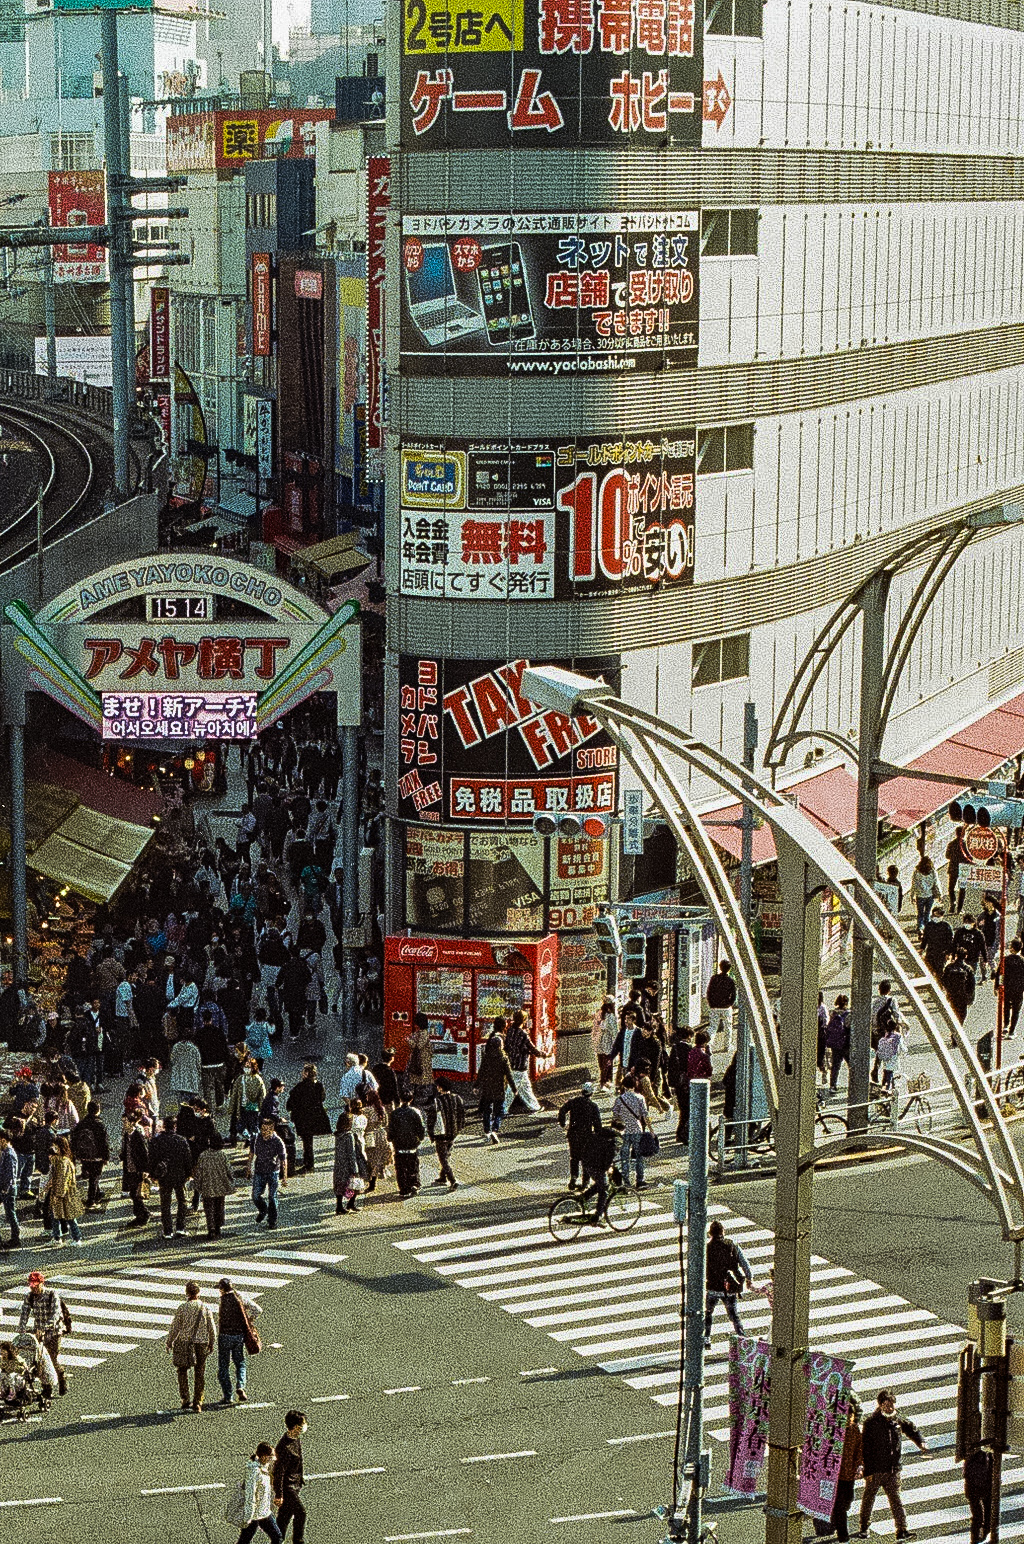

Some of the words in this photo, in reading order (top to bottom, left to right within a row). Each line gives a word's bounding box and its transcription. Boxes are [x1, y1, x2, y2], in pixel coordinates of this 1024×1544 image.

[404, 0, 514, 52] 2号店へ
[538, 0, 695, 57] 携帯電話
[409, 68, 564, 136] ゲーム
[608, 69, 695, 133] ホビー
[225, 122, 257, 155] 薬
[412, 215, 612, 231] ヨドバシカメラの公式通販サイト
[454, 244, 479, 256] スマホ
[457, 256, 476, 268] から
[555, 235, 689, 269] ネットで注文
[544, 269, 694, 310] 店舗で受け取り
[507, 354, 636, 375] www.yodobashi.com
[533, 498, 551, 506] VISA
[626, 471, 694, 514] ポイント還元
[403, 518, 449, 541] 入会金
[461, 519, 547, 565] 無料
[403, 542, 449, 566] 年会費
[79, 562, 283, 609] AMEYAYOKOCHO
[402, 569, 551, 593] 店頭にてすぐ発行
[83, 636, 289, 681] アメヤ横丁
[400, 685, 416, 764] カメラ
[417, 660, 439, 765] ヨドバシ
[112, 720, 189, 737] 어서오세요!
[576, 746, 617, 770] STORE
[400, 769, 423, 799] TAX
[412, 781, 443, 812] FREE
[454, 782, 613, 812] 免税品取扱店
[512, 891, 542, 908] VISA
